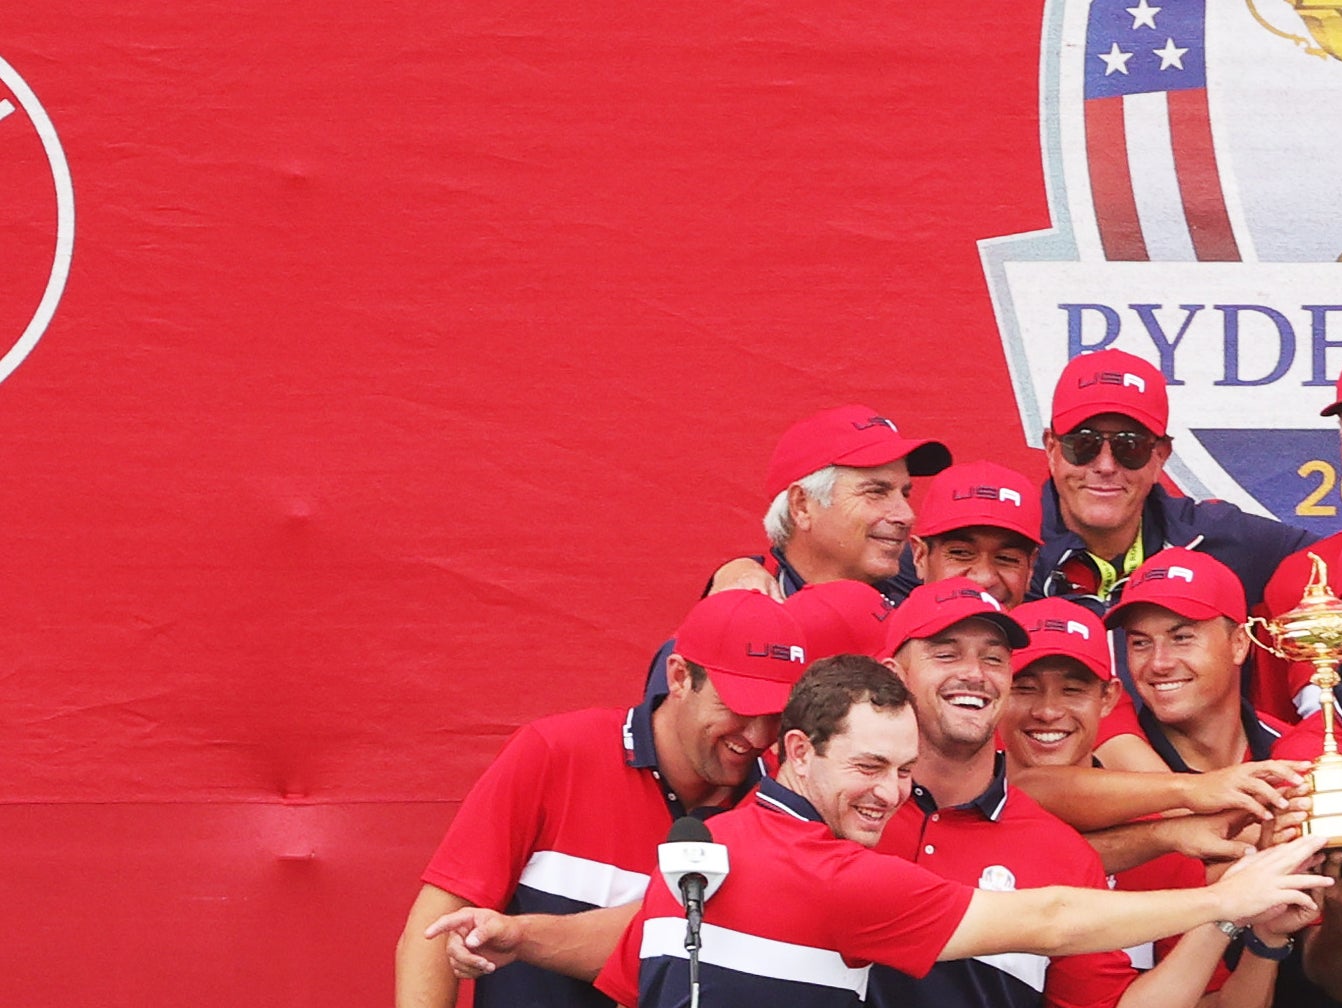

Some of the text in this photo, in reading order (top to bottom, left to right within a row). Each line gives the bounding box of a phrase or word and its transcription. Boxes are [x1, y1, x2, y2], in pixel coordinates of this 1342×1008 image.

[1077, 371, 1146, 394] USA
[952, 486, 1022, 507] USA
[1129, 564, 1194, 588] USA
[1027, 618, 1090, 640] USA
[745, 642, 806, 664] USA
